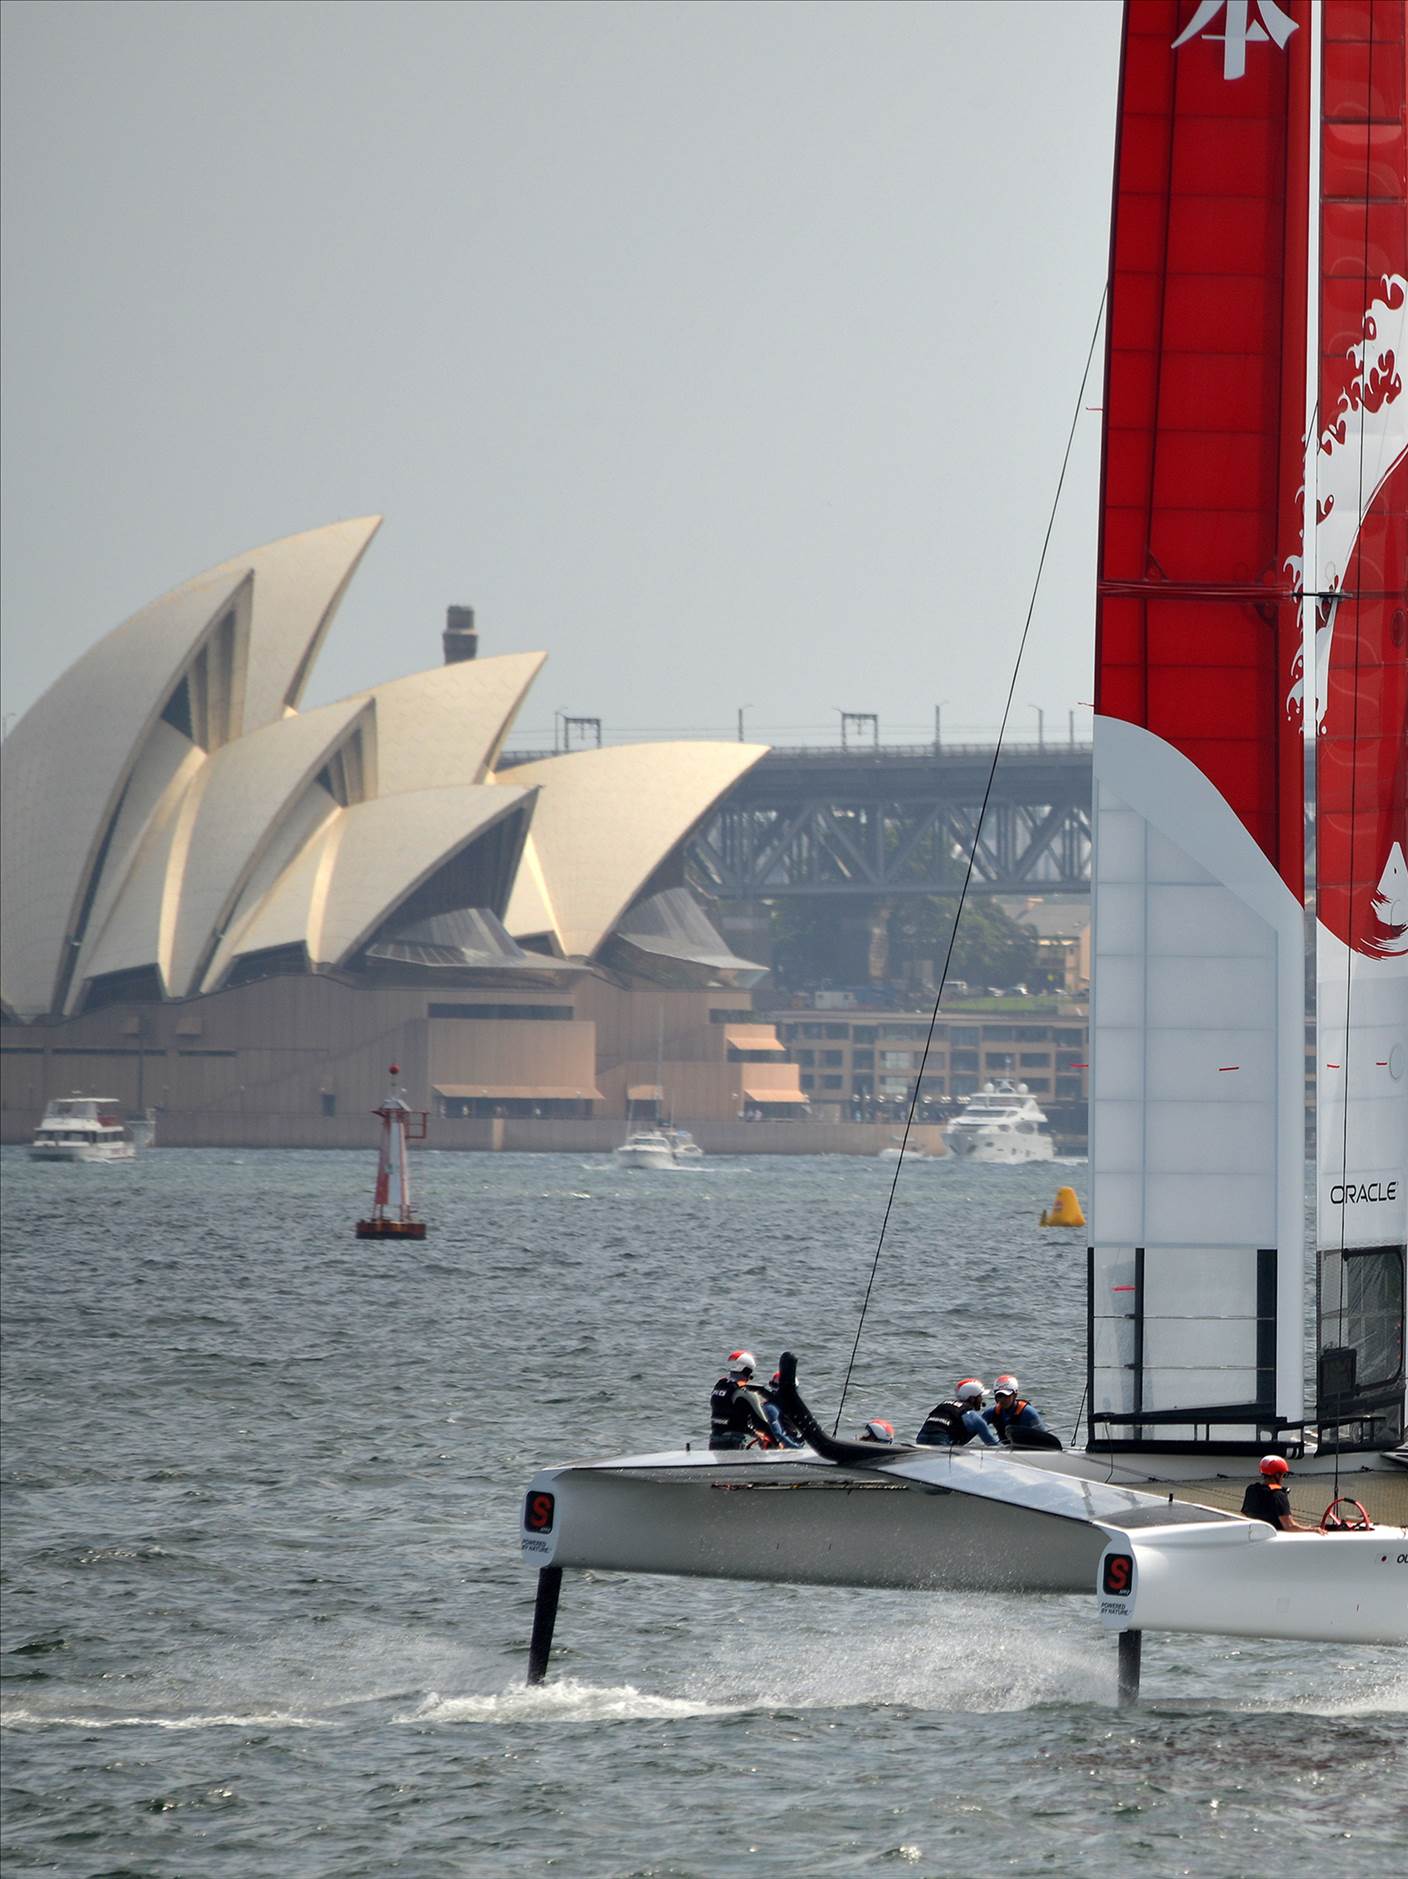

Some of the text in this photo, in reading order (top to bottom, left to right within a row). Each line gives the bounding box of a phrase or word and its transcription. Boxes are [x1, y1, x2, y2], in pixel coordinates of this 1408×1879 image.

[1330, 1181, 1397, 1205] ORACLE
[531, 1495, 552, 1526] S
[1107, 1557, 1129, 1589] S
[1101, 1602, 1125, 1610] POWERED
